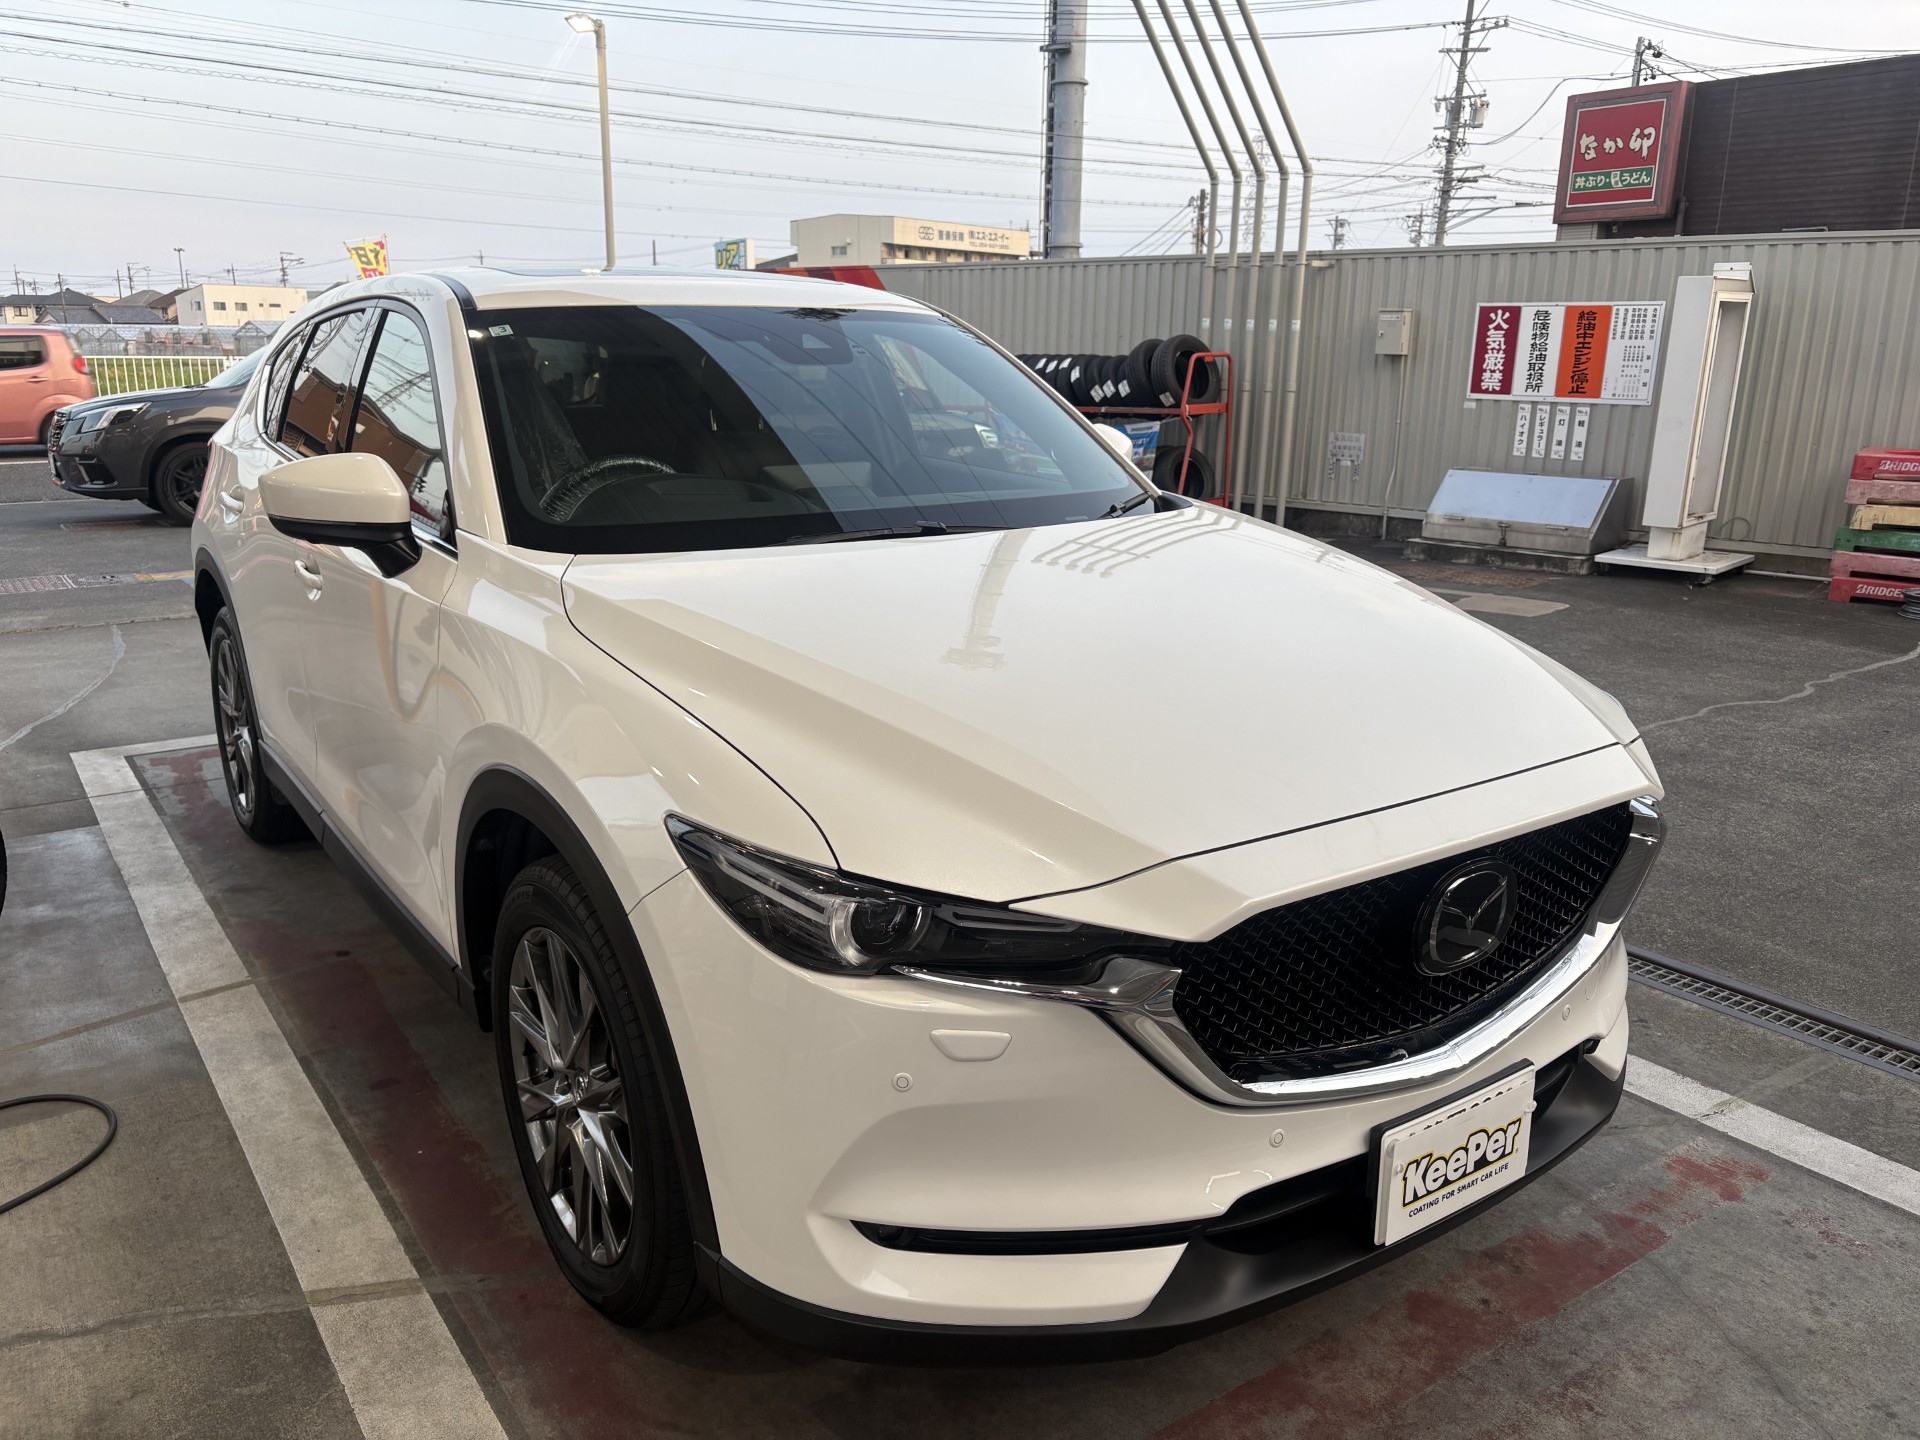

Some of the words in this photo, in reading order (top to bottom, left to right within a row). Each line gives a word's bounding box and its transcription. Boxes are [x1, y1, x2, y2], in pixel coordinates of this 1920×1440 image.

[1580, 127, 1656, 160] なか卯
[1481, 309, 1510, 391] 火気厳禁
[1525, 309, 1551, 393] 危険物給油取扱所
[1568, 310, 1597, 394] 給油中エンジン停止
[1517, 414, 1527, 446] ハイオク
[1537, 414, 1546, 448] レギュラー
[1878, 460, 1920, 472] BRIDG
[1855, 584, 1904, 598] BRIDGE
[1402, 1118, 1522, 1207] KeePer
[1408, 1197, 1440, 1218] COATING
[1441, 1189, 1455, 1202] FOR
[1456, 1178, 1479, 1195] SMART
[1480, 1170, 1493, 1182] CAR
[1494, 1162, 1509, 1176] LIFE
